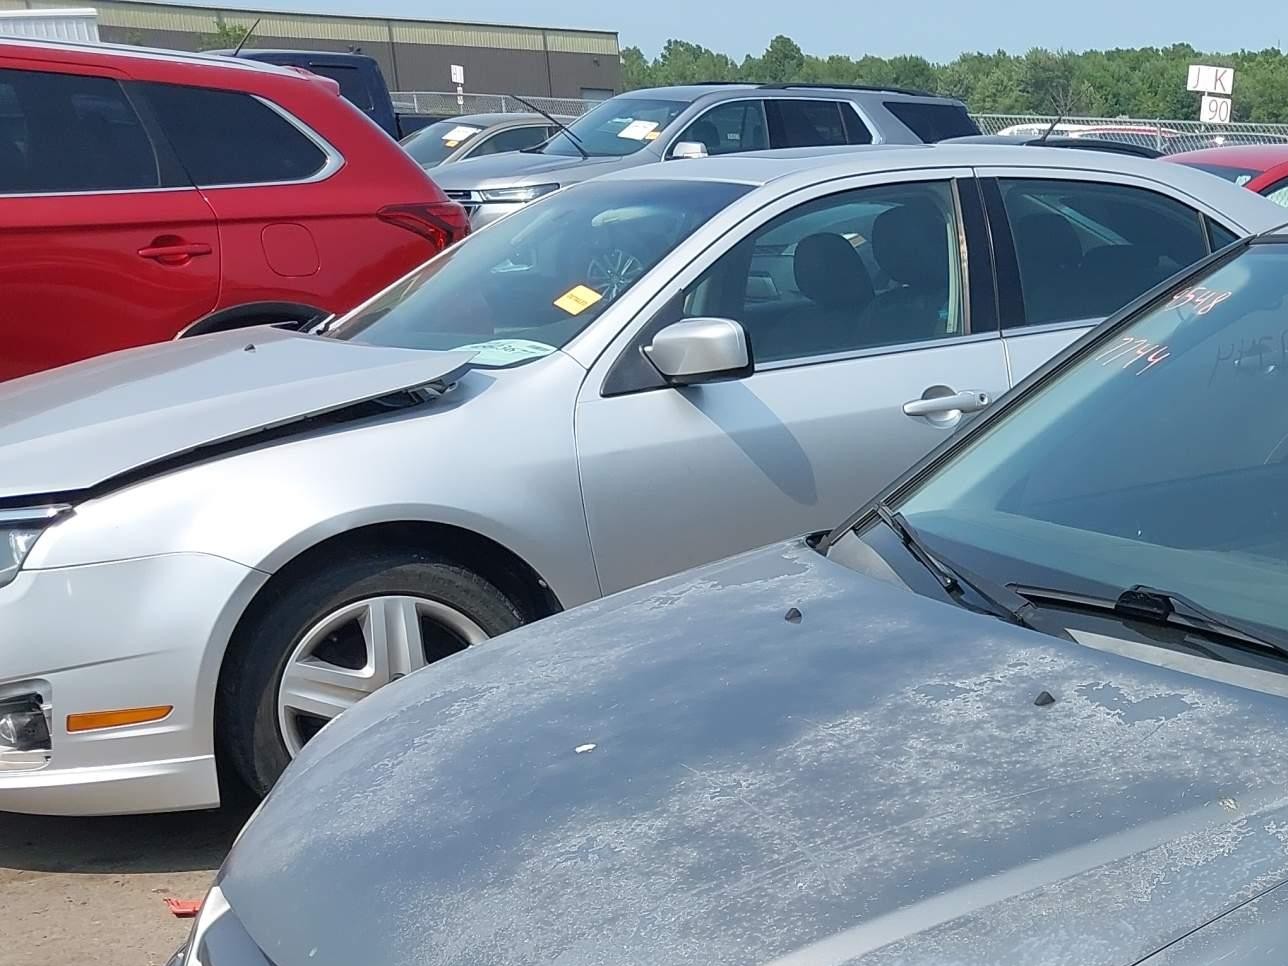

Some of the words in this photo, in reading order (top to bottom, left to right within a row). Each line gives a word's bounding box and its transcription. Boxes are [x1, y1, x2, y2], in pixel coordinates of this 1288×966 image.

[1193, 67, 1200, 89] J
[1214, 69, 1227, 92] K
[1209, 99, 1228, 122] 90
[1095, 338, 1171, 376] 7744
